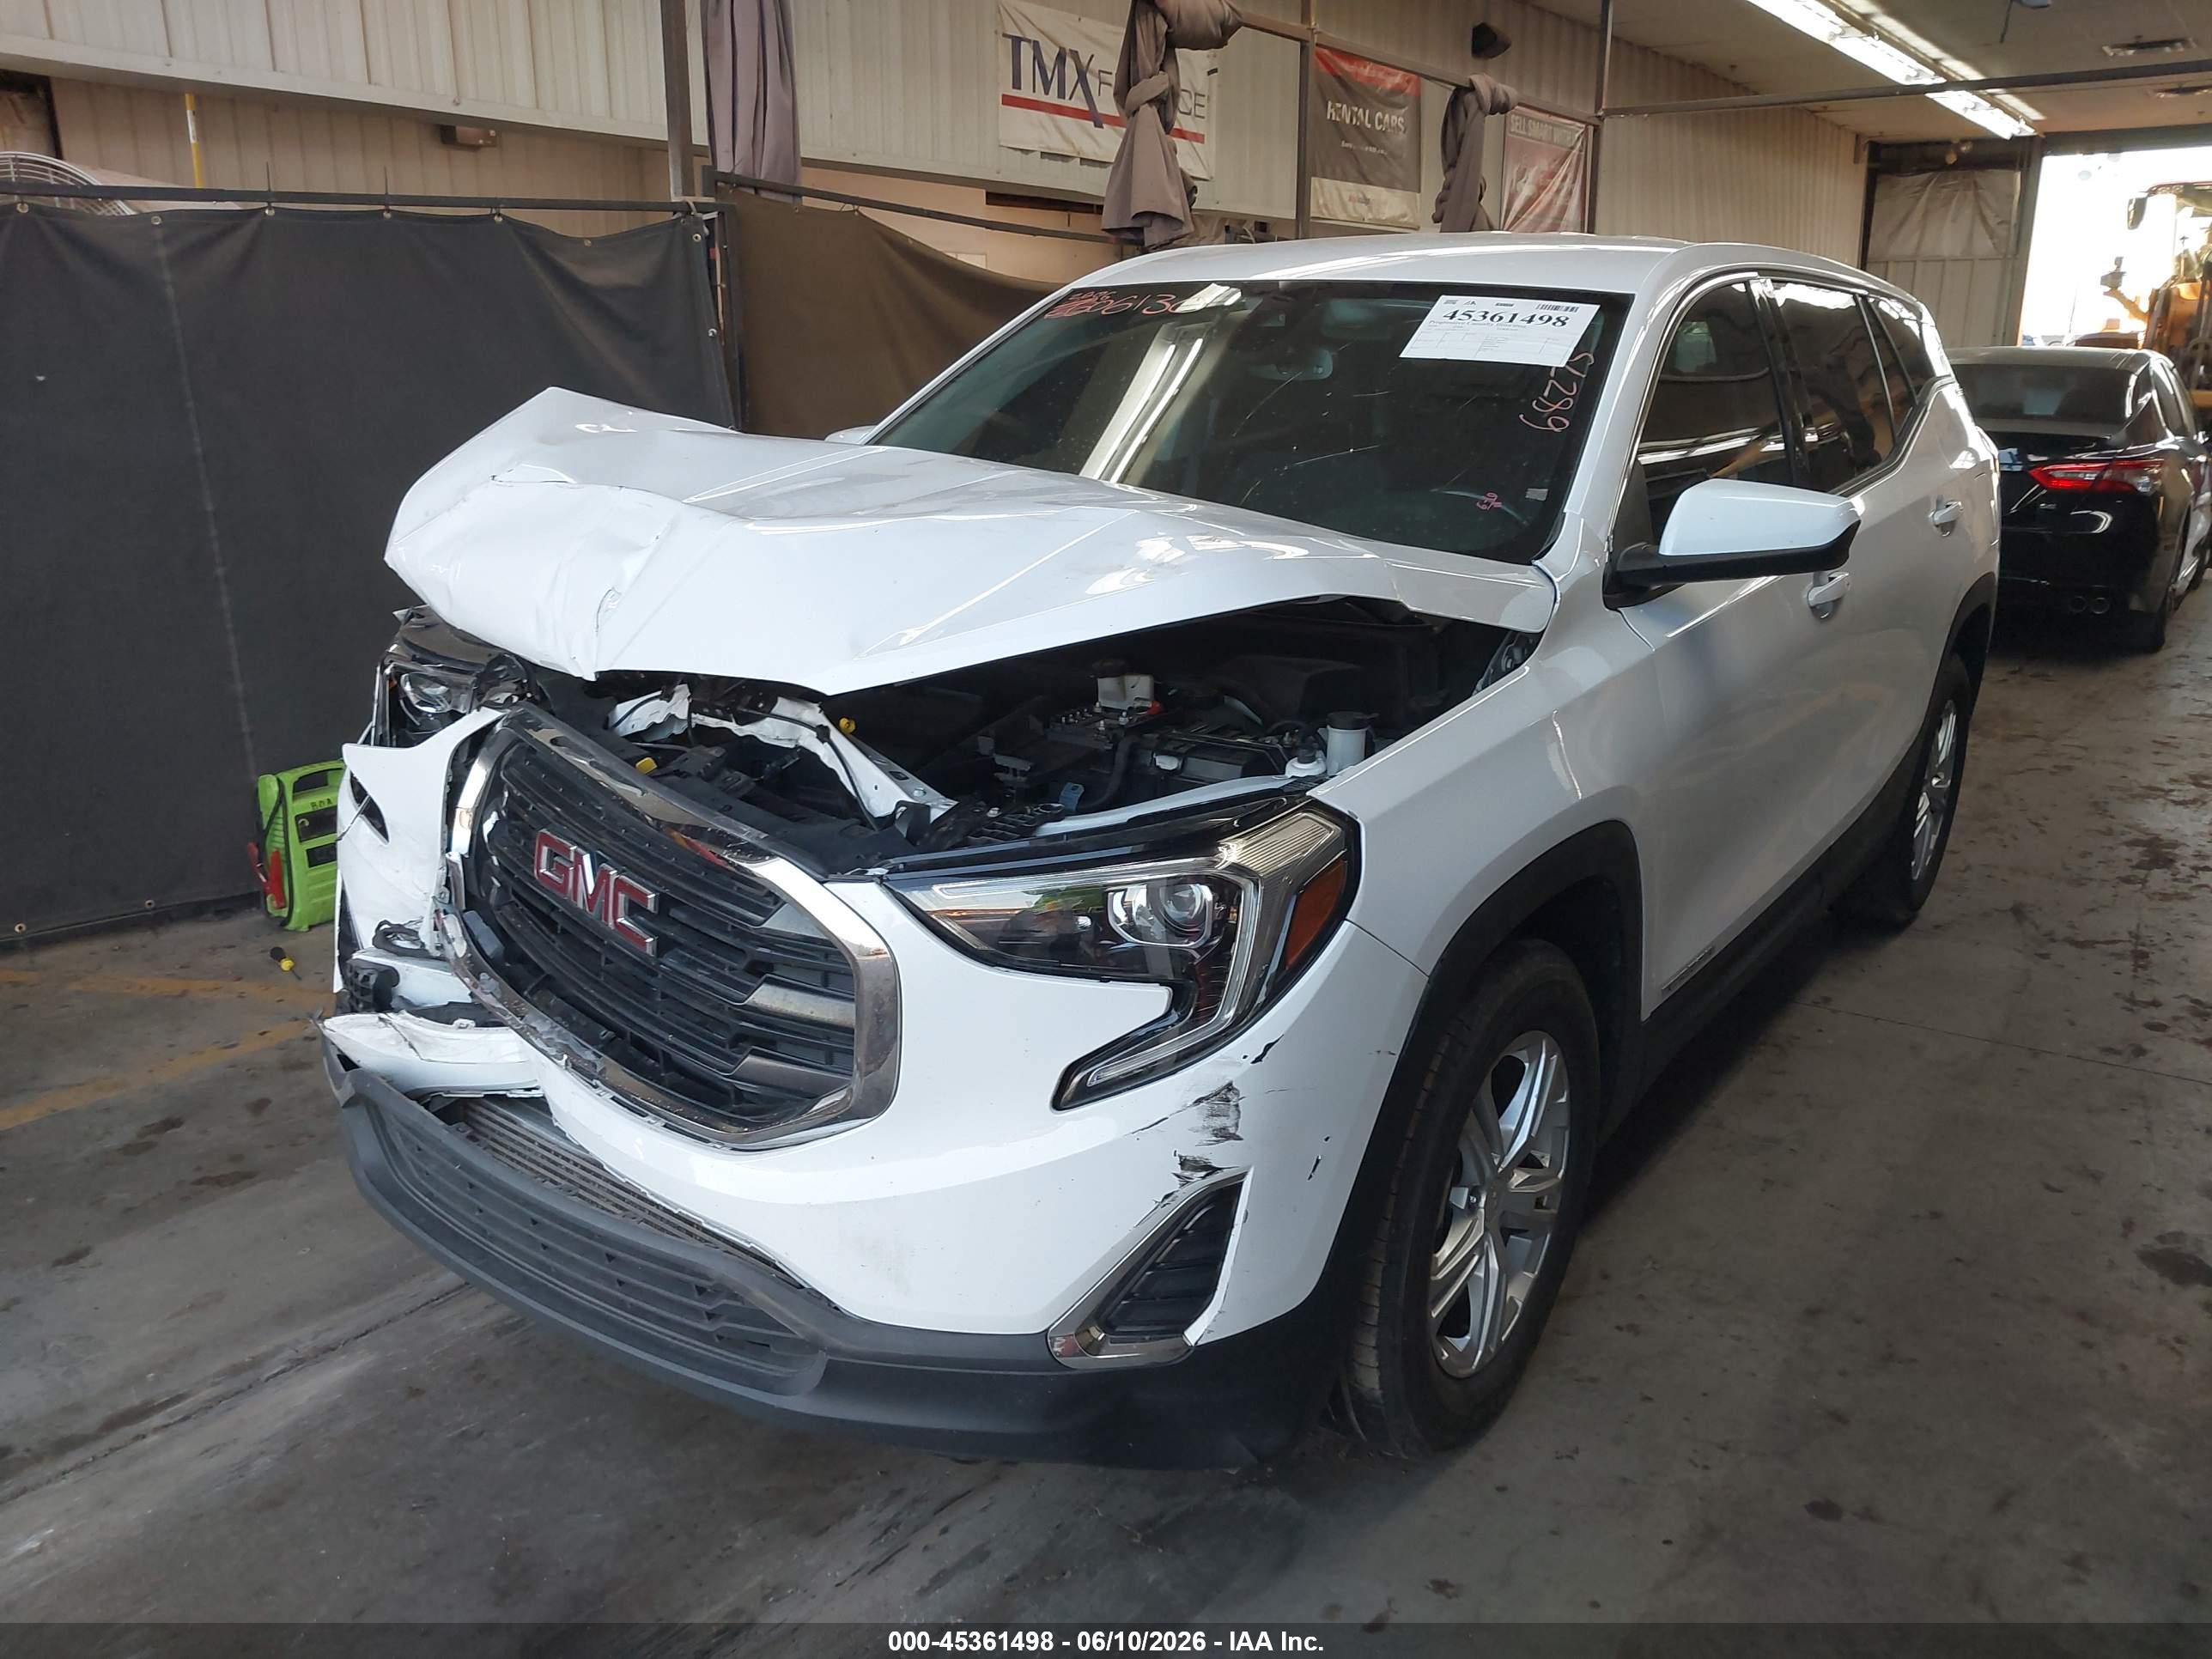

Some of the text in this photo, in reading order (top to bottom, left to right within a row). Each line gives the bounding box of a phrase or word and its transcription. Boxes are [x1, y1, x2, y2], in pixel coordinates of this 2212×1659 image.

[1002, 33, 1104, 129] TMX
[1327, 100, 1406, 132] RENTAL CARS
[1443, 309, 1571, 328] 45361498
[534, 828, 659, 958] GMC
